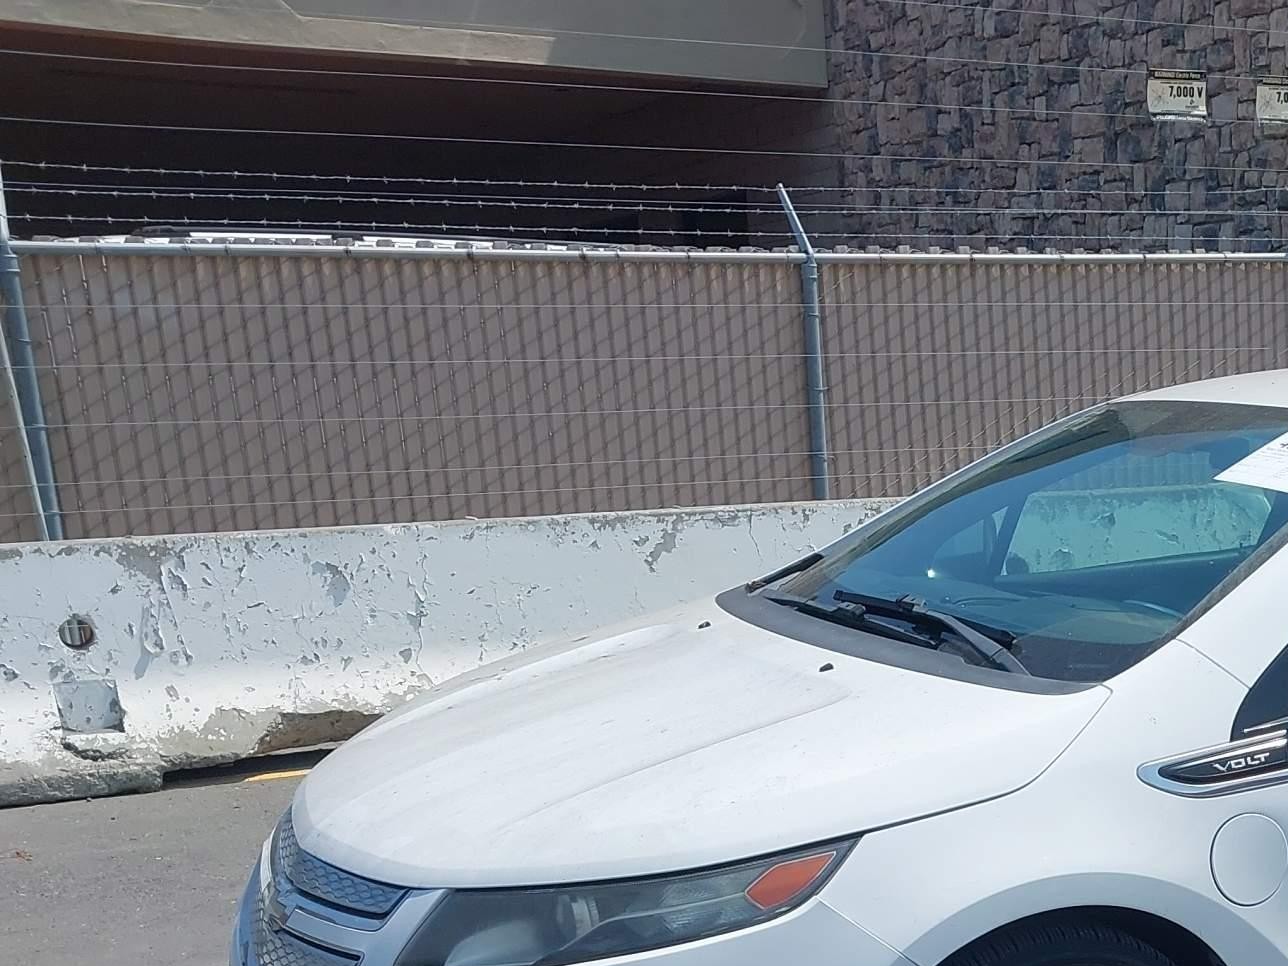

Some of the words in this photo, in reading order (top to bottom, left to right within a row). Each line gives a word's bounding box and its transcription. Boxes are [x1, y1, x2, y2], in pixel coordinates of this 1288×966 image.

[1168, 85, 1195, 99] 7,000
[1196, 86, 1204, 99] V
[1212, 752, 1270, 772] VOLT
